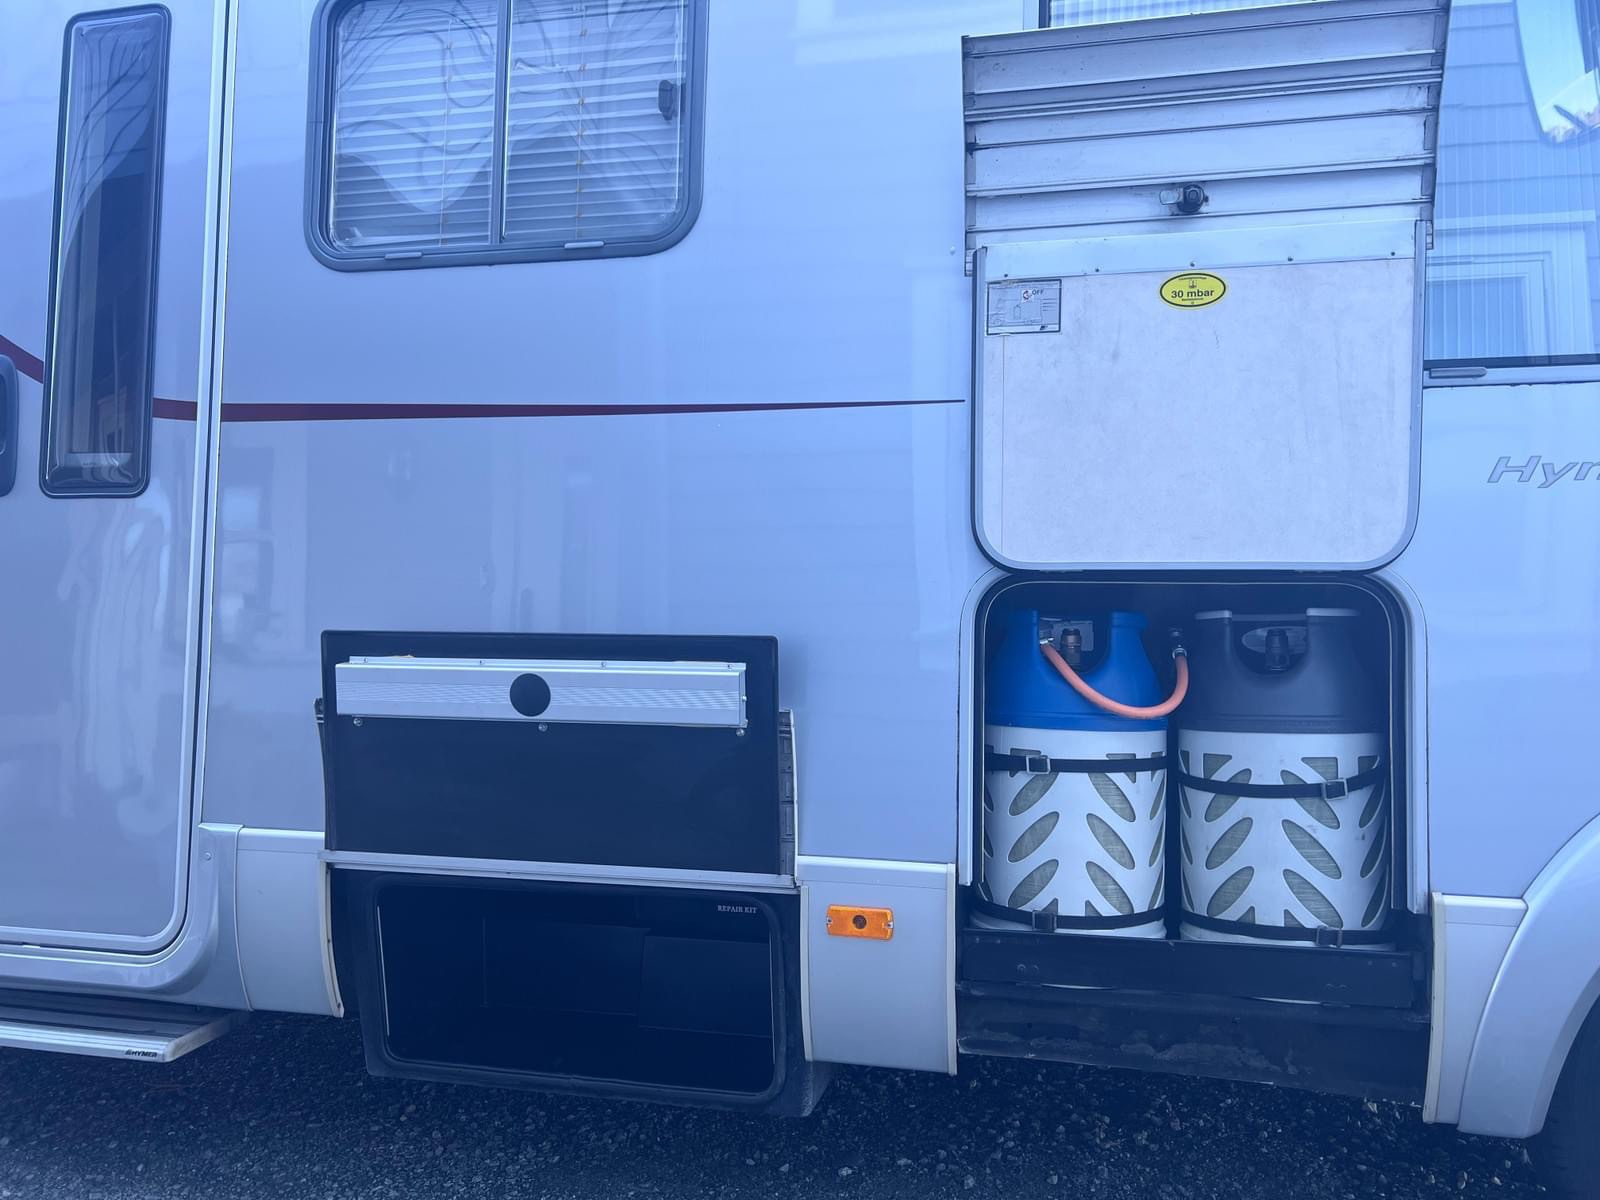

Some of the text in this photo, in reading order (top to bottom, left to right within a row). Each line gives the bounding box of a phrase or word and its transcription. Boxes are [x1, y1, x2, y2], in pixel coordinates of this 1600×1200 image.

[1171, 290, 1184, 299] 30
[1187, 289, 1215, 298] mbar
[717, 904, 743, 913] REPAIR
